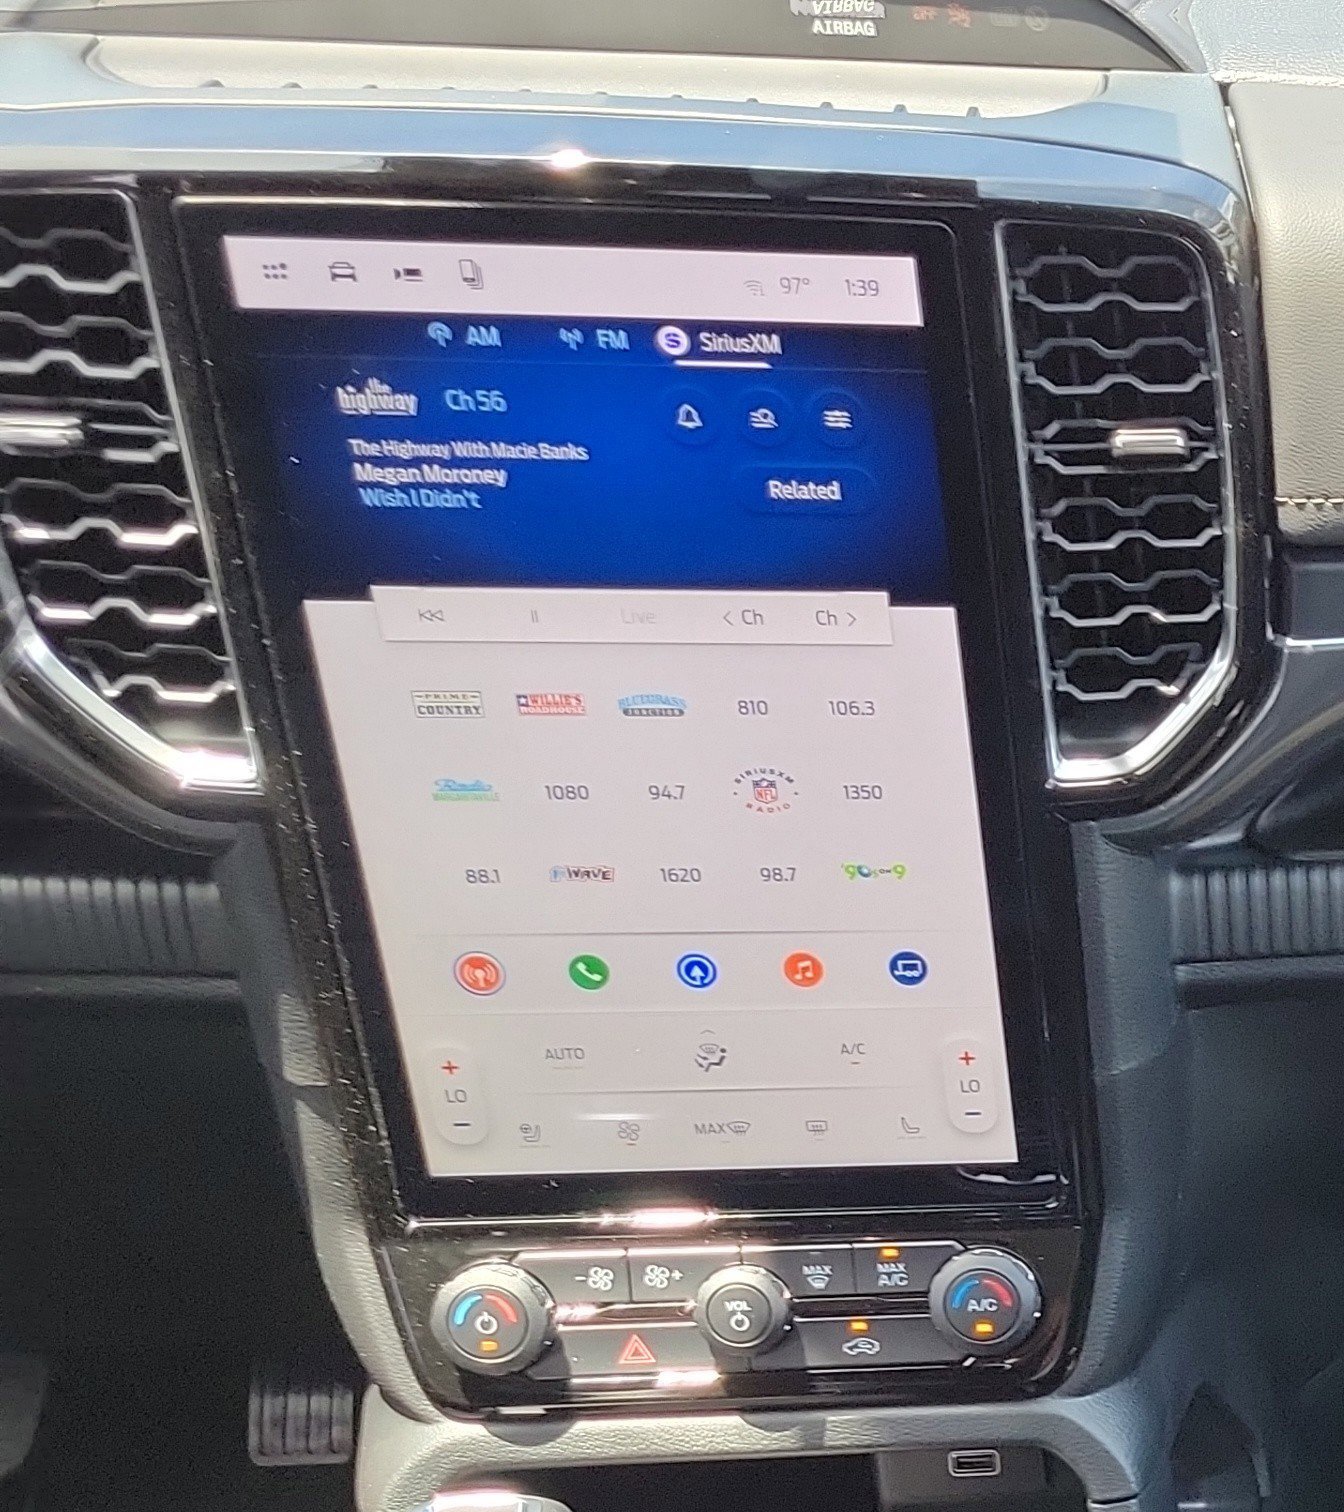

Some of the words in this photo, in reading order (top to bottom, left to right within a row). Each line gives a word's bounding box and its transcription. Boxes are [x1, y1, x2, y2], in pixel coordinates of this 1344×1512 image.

[812, 20, 877, 36] AIRBAG
[845, 279, 879, 297] 1:39
[466, 325, 502, 348] AM
[596, 328, 630, 350] FM
[700, 331, 783, 356] SiriusXM
[336, 386, 418, 416] highway
[445, 389, 475, 412] Ch
[476, 390, 507, 412] 56
[348, 439, 383, 457] The
[384, 440, 450, 460] Highway
[451, 440, 491, 458] With
[539, 442, 590, 461] Banks
[354, 462, 421, 486] Megan
[422, 464, 508, 488] Moroney
[768, 479, 842, 501] Related
[359, 487, 410, 508] Wish
[420, 488, 482, 509] Didn't
[741, 609, 764, 626] Ch
[815, 610, 837, 626] Ch
[425, 693, 468, 701] PRIME
[529, 694, 583, 706] WILLIE'S
[418, 705, 482, 716] COUNTRY
[737, 700, 768, 715] 810
[828, 700, 875, 716] 106.3
[733, 767, 795, 784] SIRIUSXM
[544, 785, 589, 800] 1080
[648, 785, 685, 800] 94.7
[756, 789, 777, 800] NFL
[842, 784, 882, 800] 1350
[465, 869, 501, 884] 88.1
[566, 867, 612, 881] WAVE
[660, 868, 701, 883] 1620
[760, 867, 796, 882] 98.7
[545, 1048, 585, 1060] AUTO
[840, 1043, 866, 1055] A/C
[960, 1079, 981, 1094] LO
[444, 1089, 467, 1104] LO
[694, 1123, 725, 1135] MAX
[802, 1264, 832, 1275] MAX
[876, 1262, 907, 1273] MAX
[878, 1273, 908, 1286] A/C
[724, 1301, 752, 1312] VOL
[966, 1298, 998, 1312] A/C
